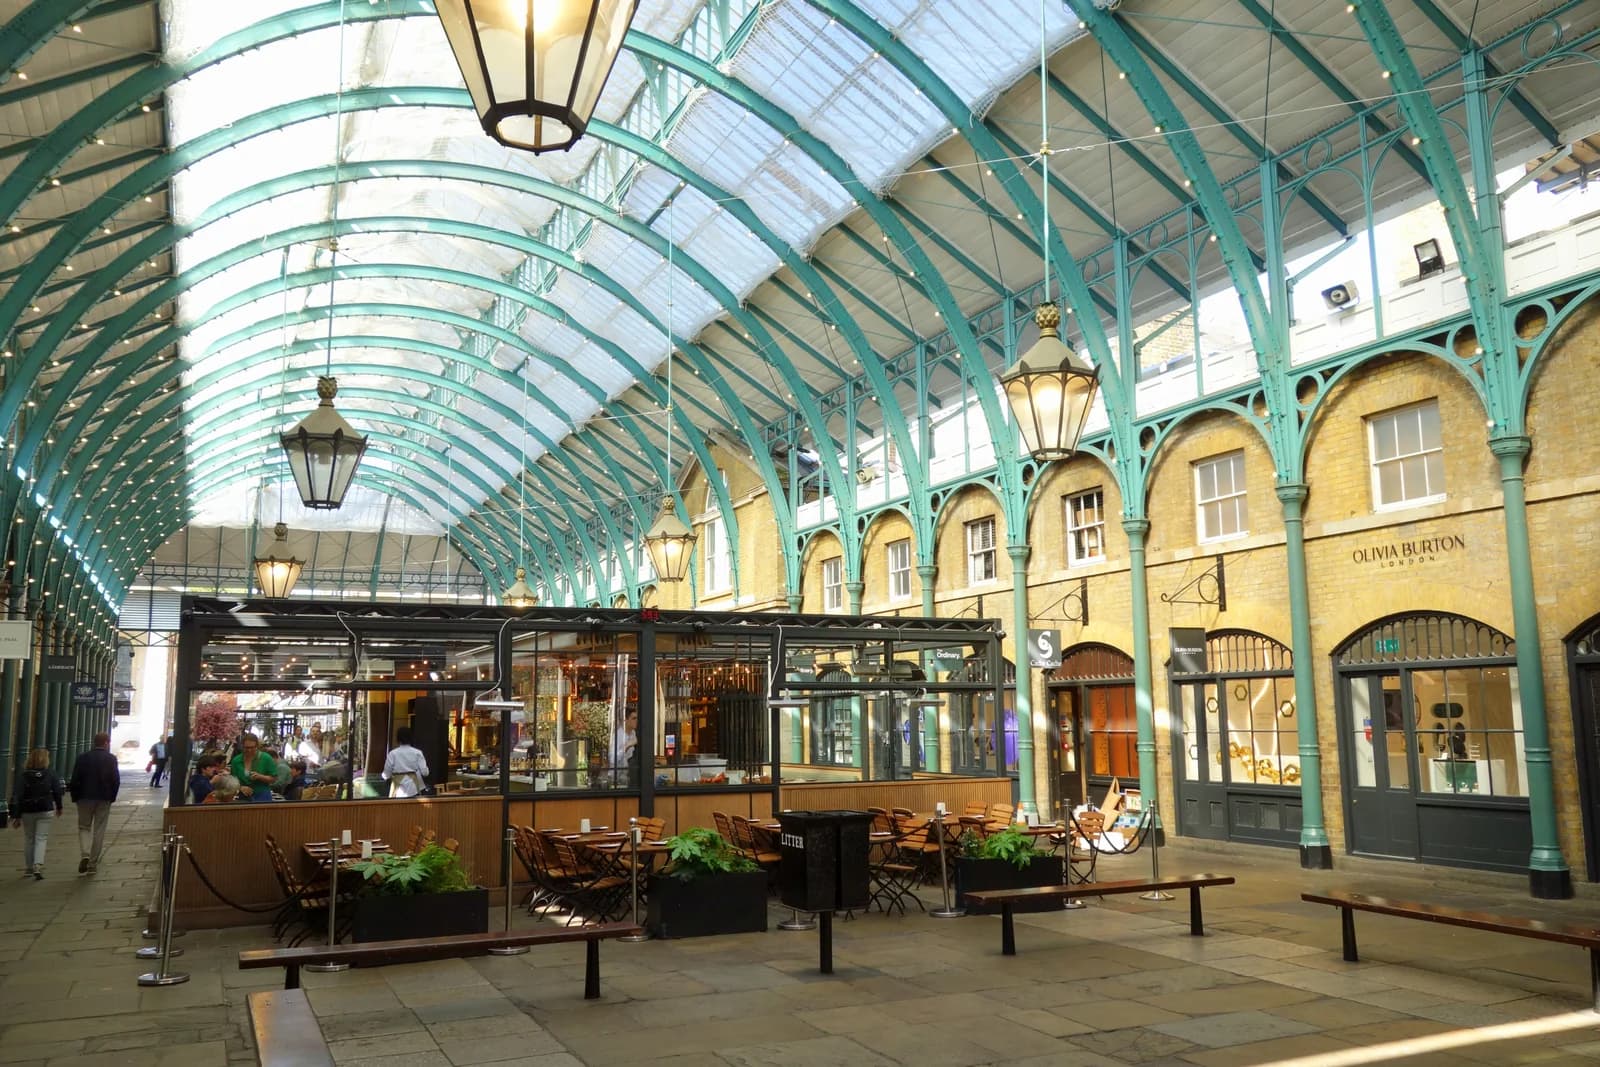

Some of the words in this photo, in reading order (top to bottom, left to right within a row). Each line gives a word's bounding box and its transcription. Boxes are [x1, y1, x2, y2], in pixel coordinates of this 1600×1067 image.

[1353, 545, 1398, 564] OLIVIA
[1402, 535, 1465, 557] BURTON
[1381, 557, 1435, 568] LONDON
[781, 833, 804, 849] LITTER
